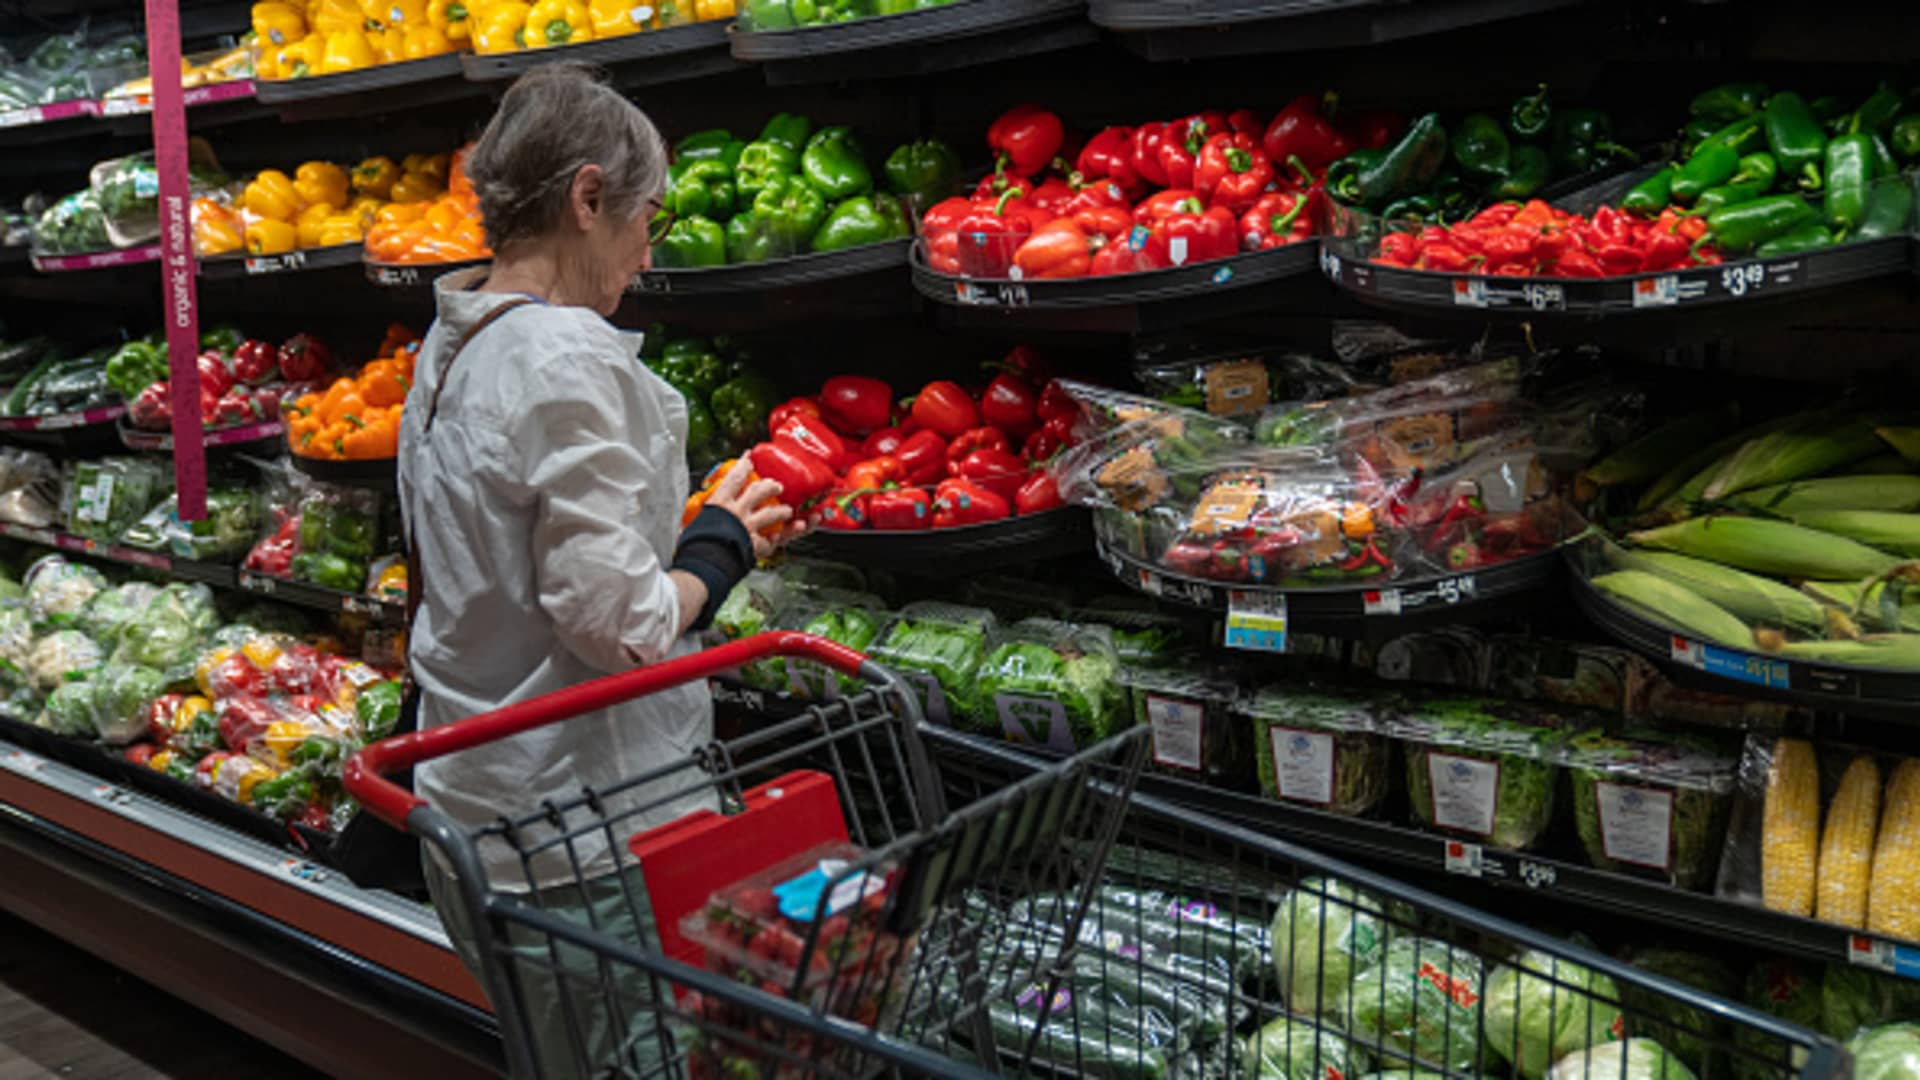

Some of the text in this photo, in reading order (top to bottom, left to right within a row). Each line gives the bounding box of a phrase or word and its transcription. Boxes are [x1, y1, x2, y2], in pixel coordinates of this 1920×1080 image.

[166, 196, 192, 327] organic & natural
